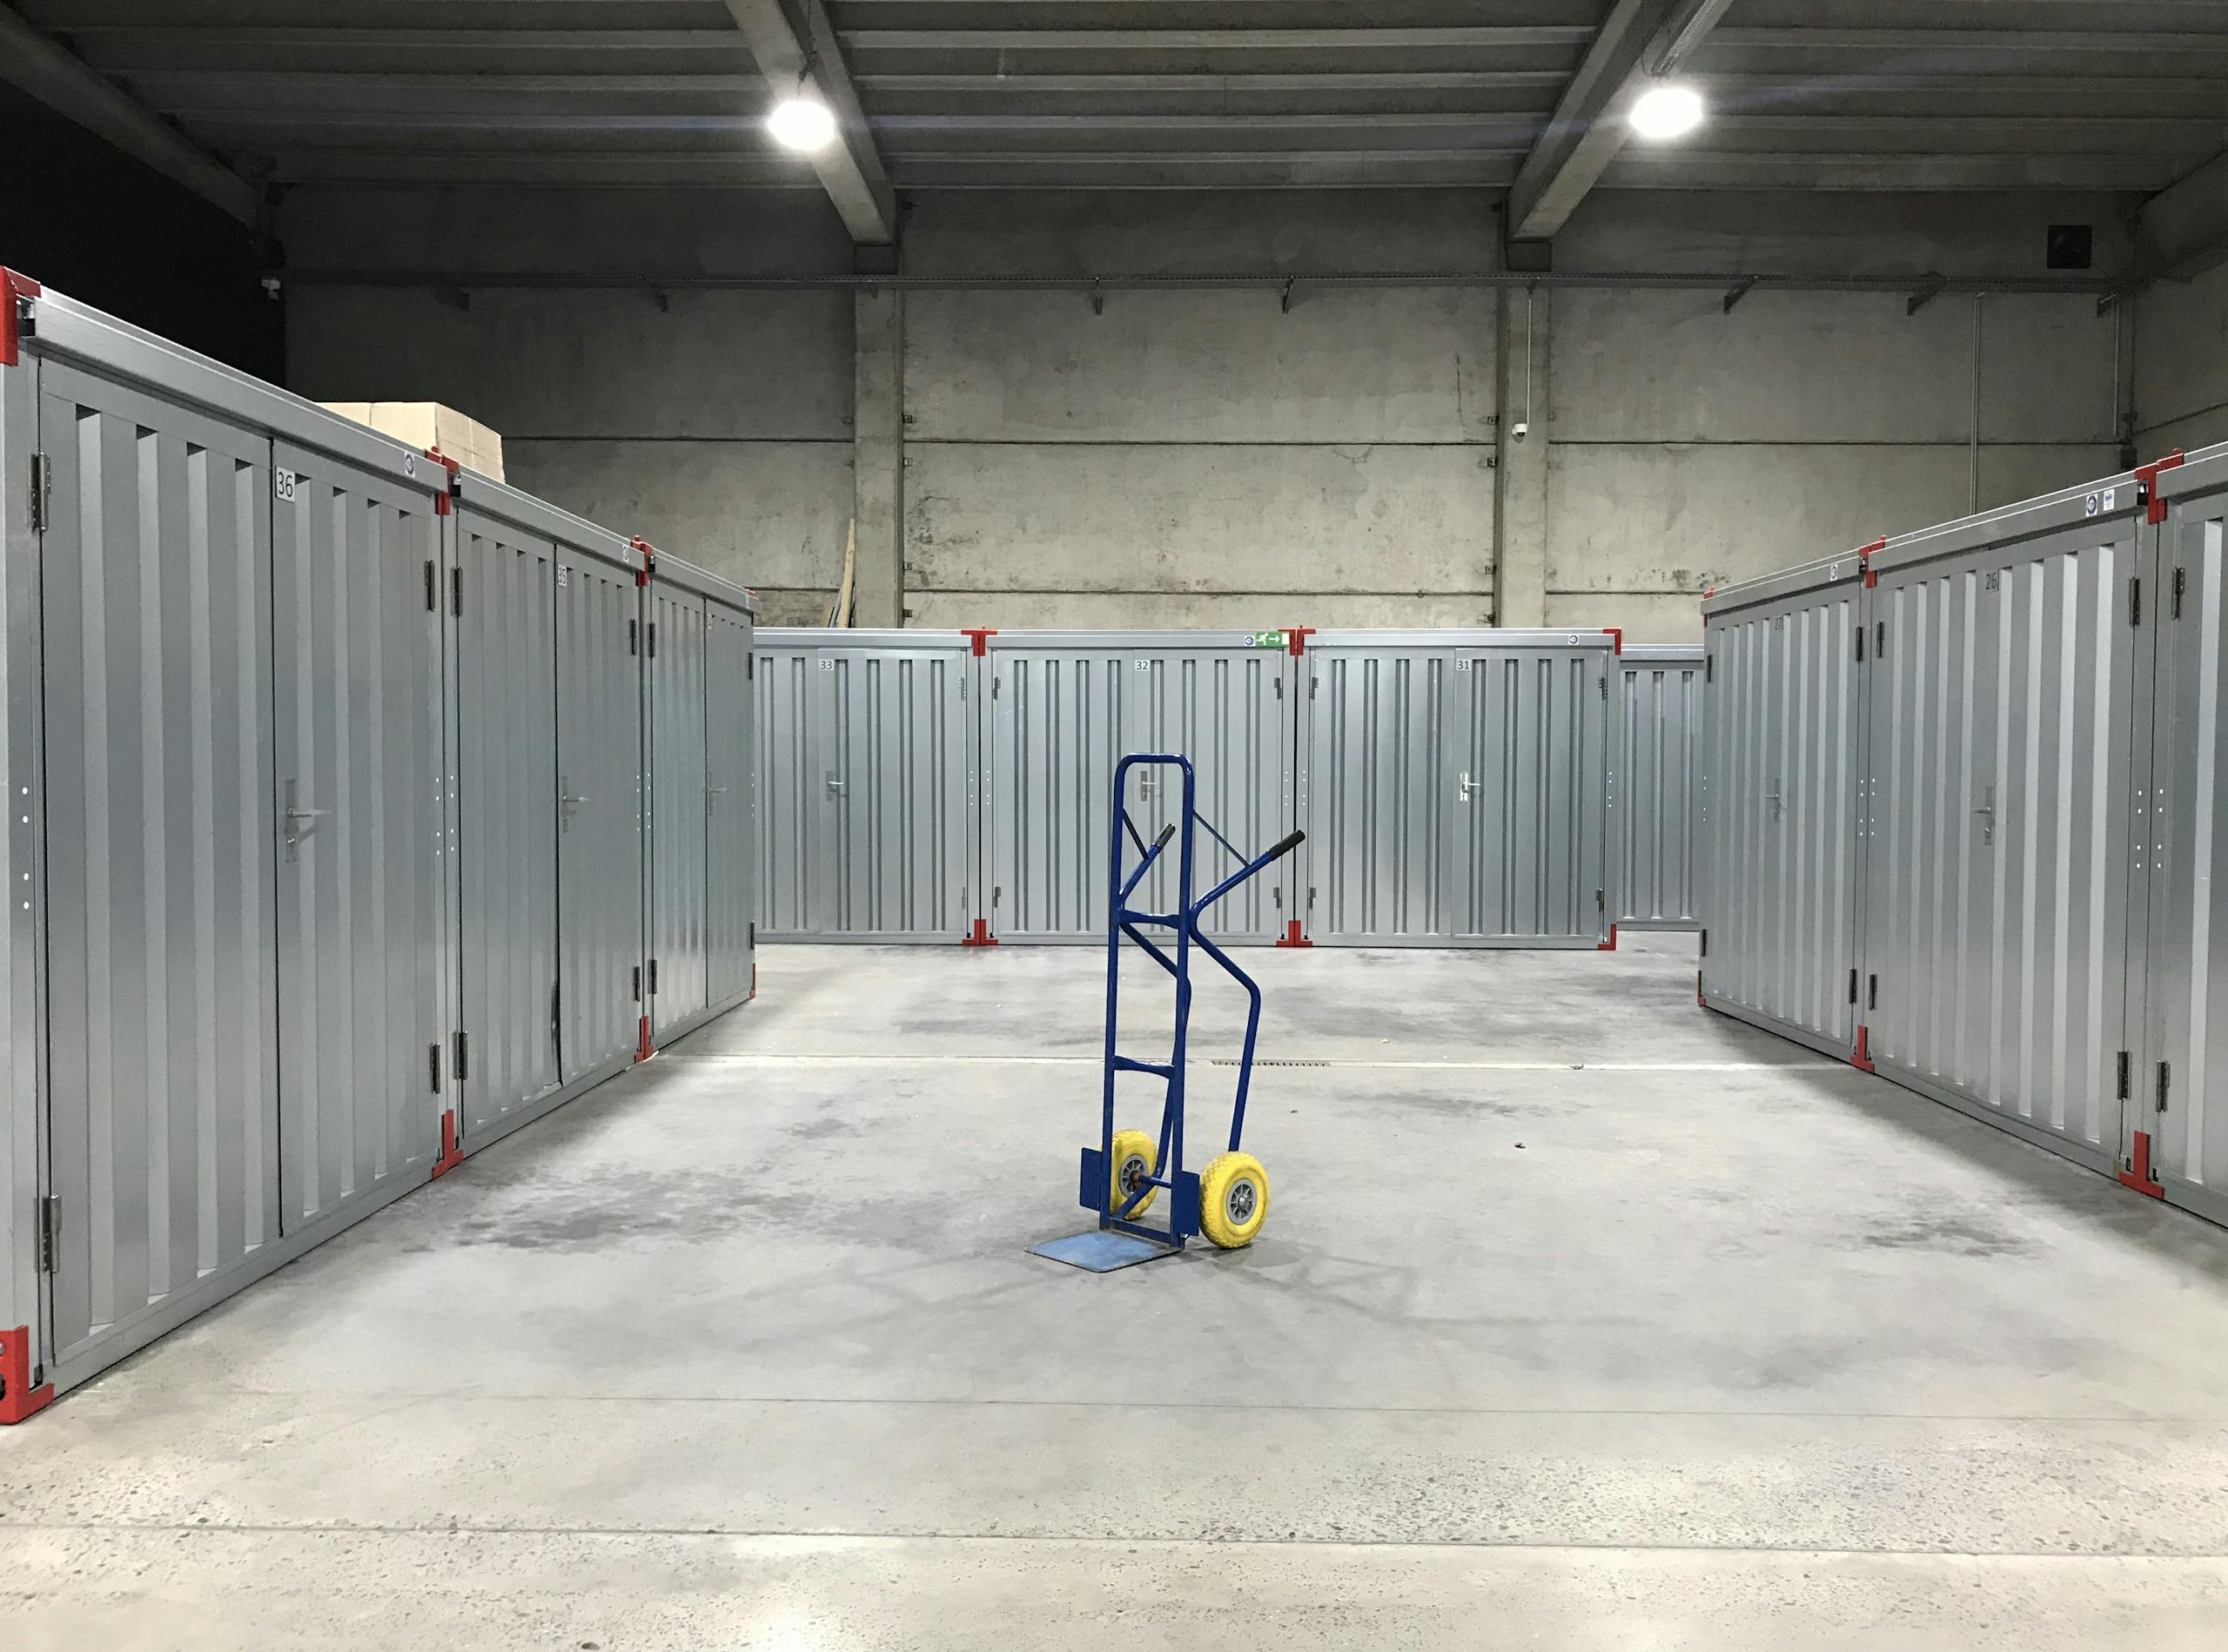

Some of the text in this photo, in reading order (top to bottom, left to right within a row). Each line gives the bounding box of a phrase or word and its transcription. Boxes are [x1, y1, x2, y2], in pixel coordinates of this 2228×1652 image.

[278, 472, 293, 497] 36
[1985, 572, 1997, 590] 26
[821, 660, 833, 670] 33
[1136, 661, 1149, 670] 32
[1457, 660, 1470, 670] 31
